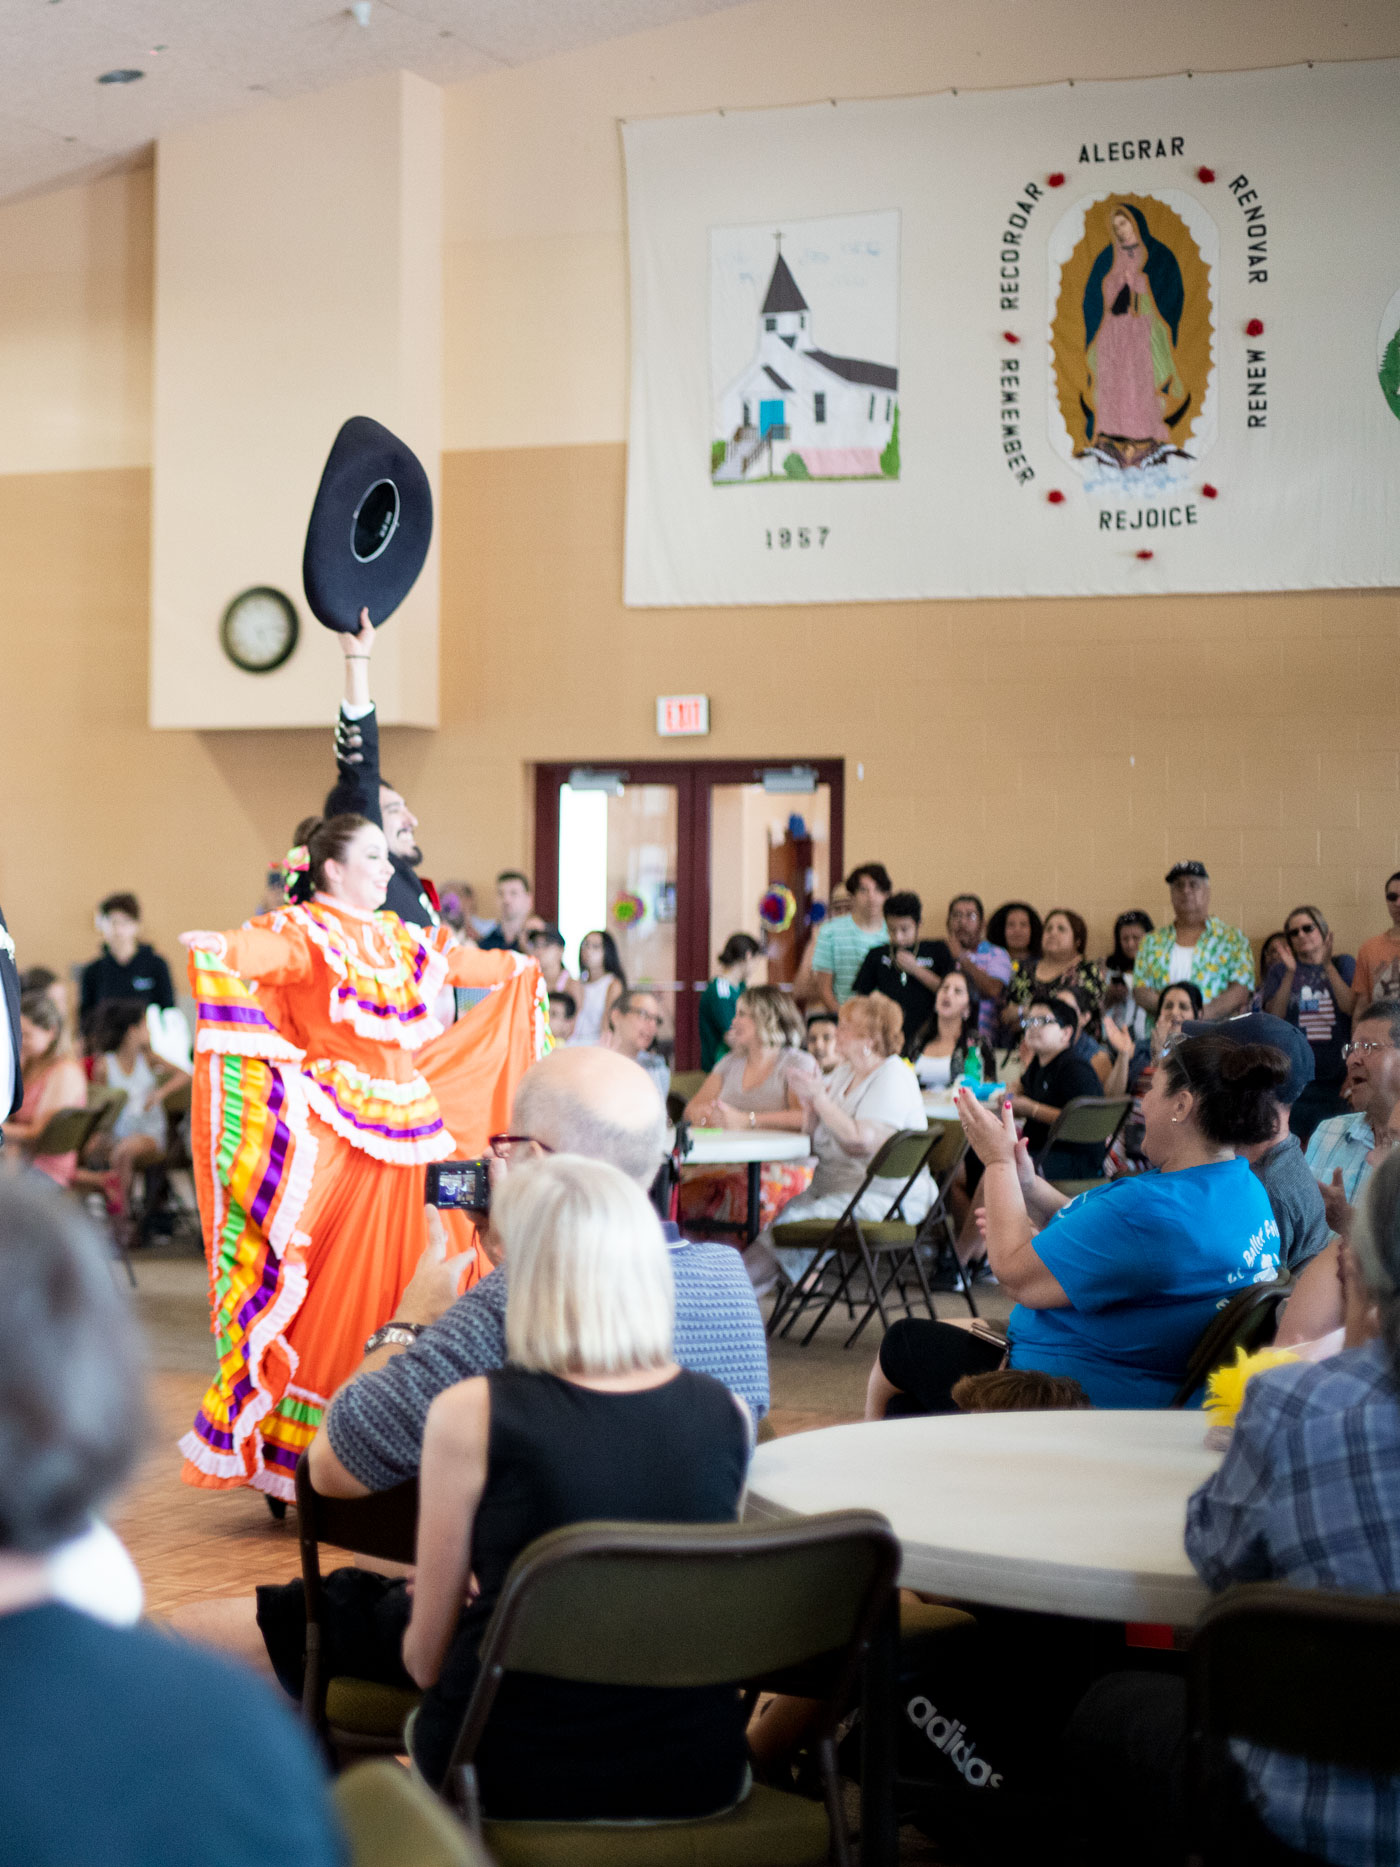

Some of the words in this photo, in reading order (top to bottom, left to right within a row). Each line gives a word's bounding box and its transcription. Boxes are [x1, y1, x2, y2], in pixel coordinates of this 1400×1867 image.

[1078, 136, 1186, 164] ALEGRAR
[1000, 181, 1044, 311] RECORDAR
[1228, 174, 1268, 285] RENOVAR
[1001, 358, 1035, 486] REMEMBER
[1247, 348, 1267, 428] RENEW
[765, 525, 831, 550] 1957
[1099, 504, 1198, 531] REJOICE
